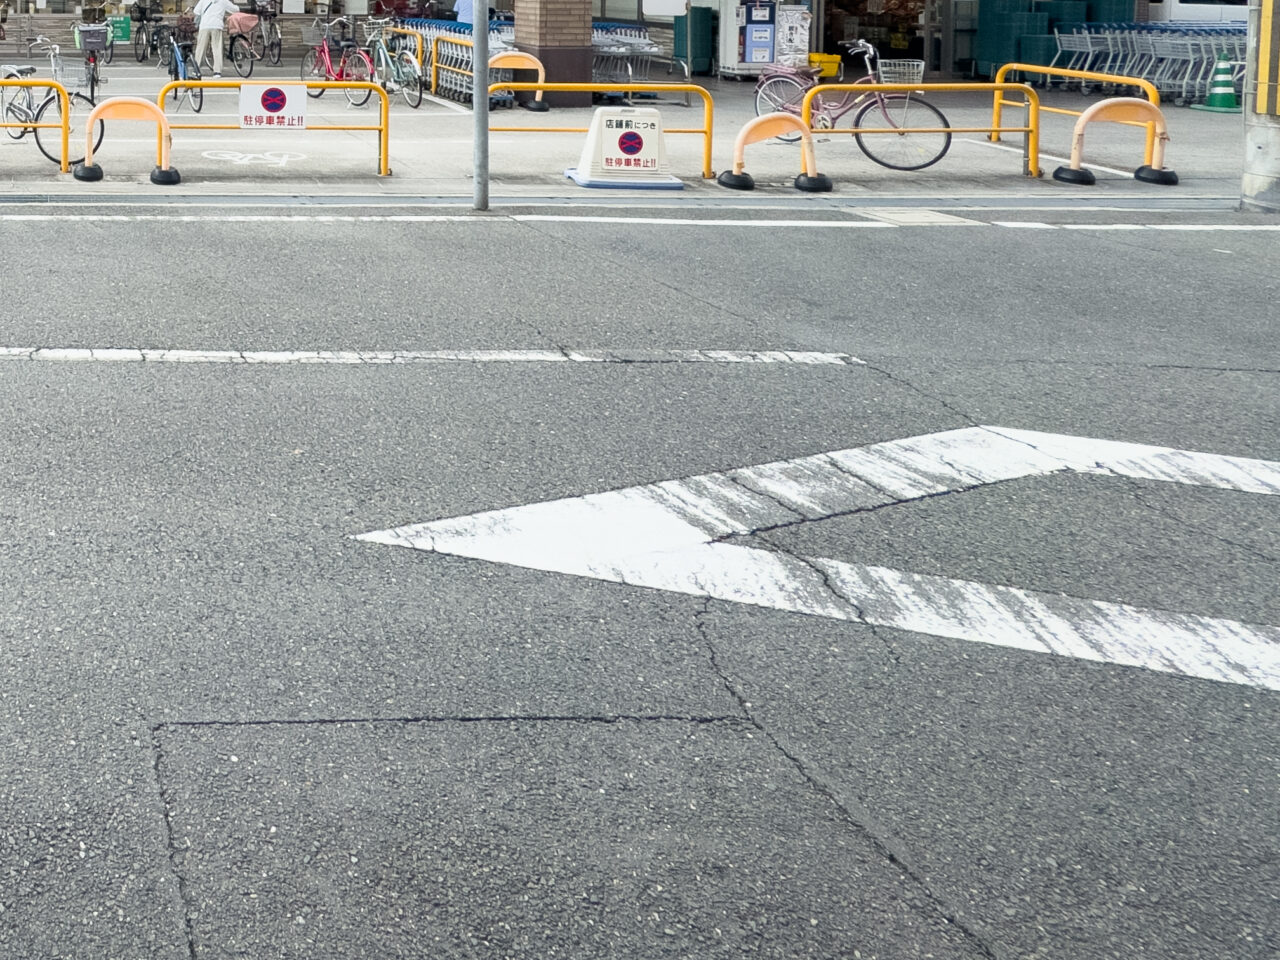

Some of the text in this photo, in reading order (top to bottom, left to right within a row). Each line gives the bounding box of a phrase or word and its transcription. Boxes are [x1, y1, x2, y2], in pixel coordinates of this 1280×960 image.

[605, 119, 657, 130] 店舗前につき
